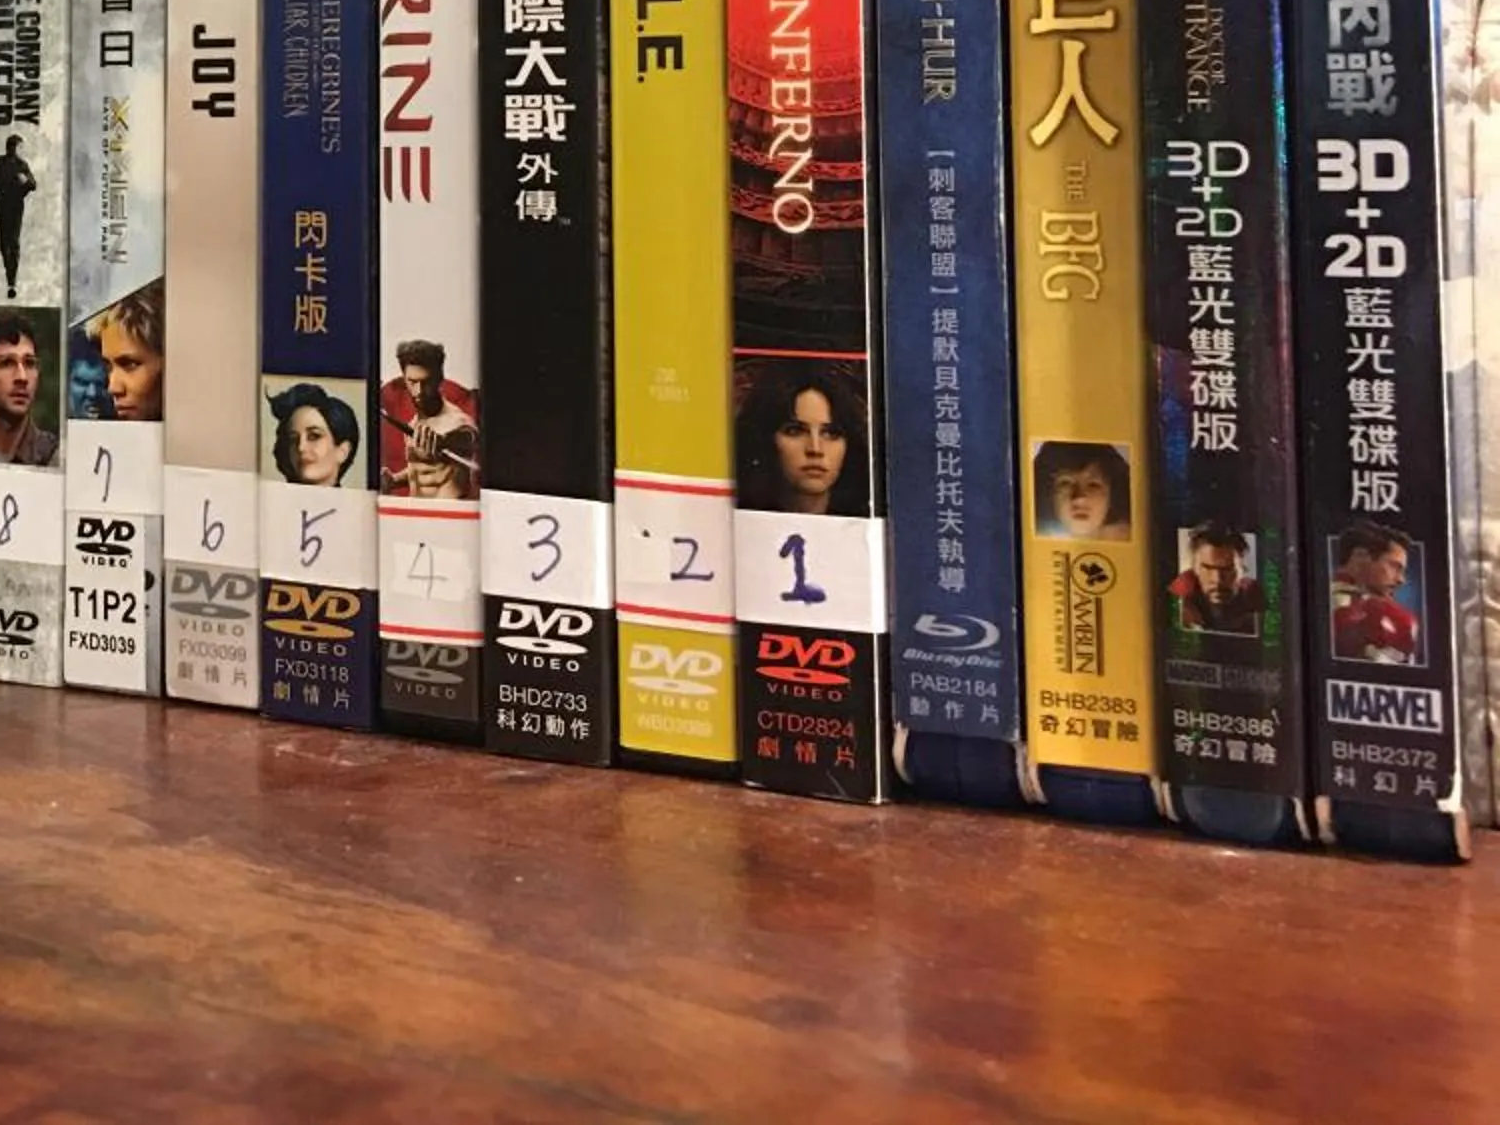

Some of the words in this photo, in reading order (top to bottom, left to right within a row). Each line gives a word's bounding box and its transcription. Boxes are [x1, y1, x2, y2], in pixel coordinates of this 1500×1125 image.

[14, 6, 42, 127] COMPANY
[191, 23, 237, 119] JOY
[293, 209, 329, 334] 閃卡版
[1037, 209, 1105, 304] BFG
[1187, 243, 1240, 453] 藍光雙碟版
[1343, 287, 1401, 513] 藍光雙碟版
[200, 499, 226, 552] 6
[299, 508, 337, 568] 5
[527, 513, 562, 582] 3
[670, 536, 714, 581] 2
[406, 543, 449, 600] 4
[778, 532, 828, 605] 1
[68, 585, 138, 625] T1P2
[499, 603, 594, 639] DVD
[68, 629, 137, 656] FXD3039
[757, 632, 856, 668] DVD
[274, 658, 349, 682] FXD3118
[506, 653, 580, 672] VIDEO
[273, 680, 350, 710] 劇情片
[498, 683, 588, 713] BHD2733
[766, 683, 844, 703] VIDEO
[909, 672, 998, 699] PAB2184
[1039, 690, 1138, 715] BHB2383
[1173, 708, 1275, 737] BHB2386
[1330, 682, 1439, 731] MARVEL
[496, 709, 591, 741] 科幻動作
[757, 710, 855, 741] CTD2824
[1039, 715, 1140, 743] 奇幻冒險
[1173, 733, 1277, 764] 奇幻冒險
[1332, 741, 1437, 768] BHB2372
